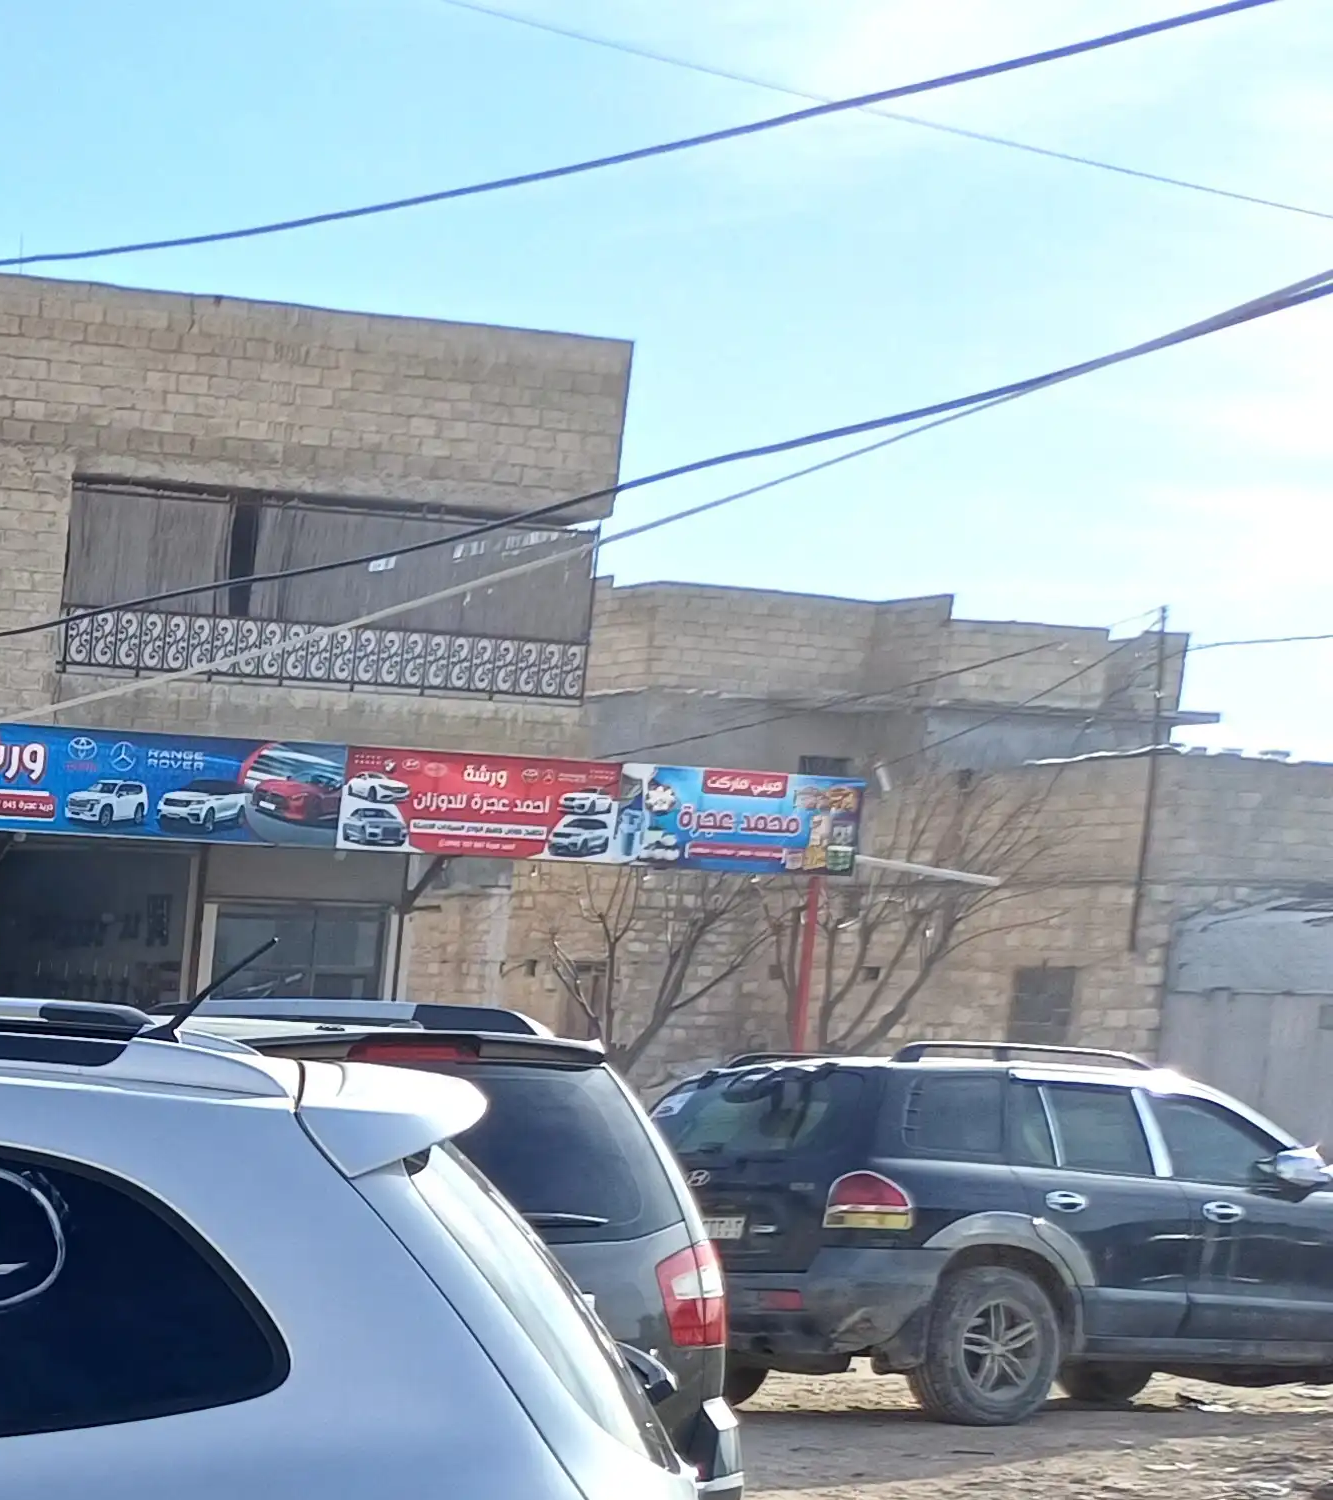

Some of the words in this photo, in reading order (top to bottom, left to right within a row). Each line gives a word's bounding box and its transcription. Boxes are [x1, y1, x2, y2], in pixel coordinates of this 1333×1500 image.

[147, 748, 205, 760] RANGE
[147, 759, 205, 770] ROVER
[463, 764, 509, 788] ورشة
[471, 792, 510, 815] عجرة
[676, 803, 735, 838] عجرة
[738, 812, 802, 837] محمد
